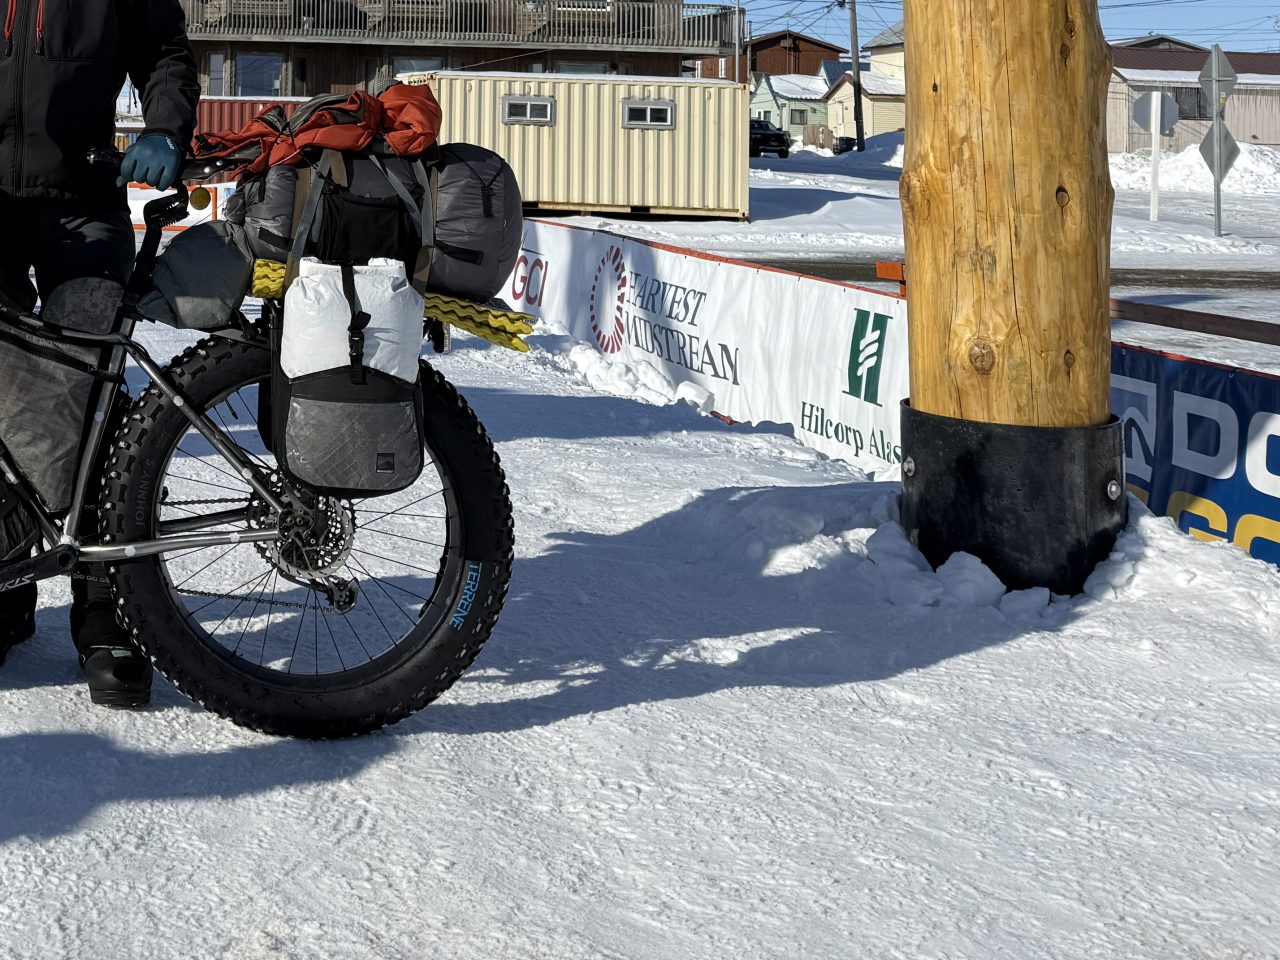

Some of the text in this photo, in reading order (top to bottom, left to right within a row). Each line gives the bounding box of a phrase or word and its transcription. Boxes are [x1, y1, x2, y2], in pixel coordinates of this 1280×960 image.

[511, 254, 548, 308] GCI
[625, 271, 707, 327] HARVEST
[800, 401, 864, 458] Hilcorp
[135, 471, 150, 527] JOHNNY
[448, 562, 483, 631] TERRENE
